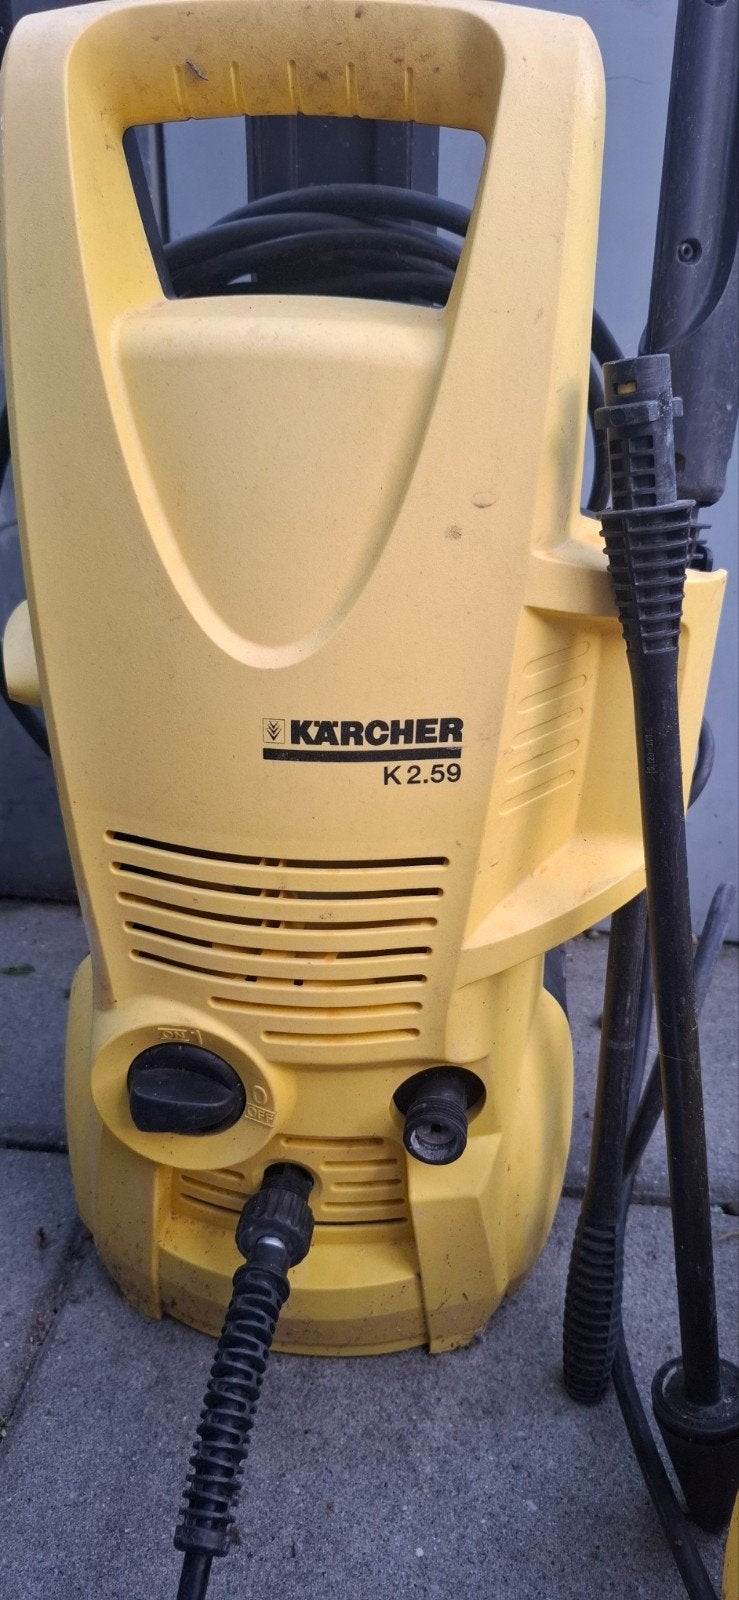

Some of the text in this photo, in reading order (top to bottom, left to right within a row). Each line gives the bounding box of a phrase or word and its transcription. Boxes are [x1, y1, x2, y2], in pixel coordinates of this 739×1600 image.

[290, 717, 464, 746] KÄRCHER
[383, 762, 462, 786] K 2.59
[247, 1106, 274, 1124] OFF
